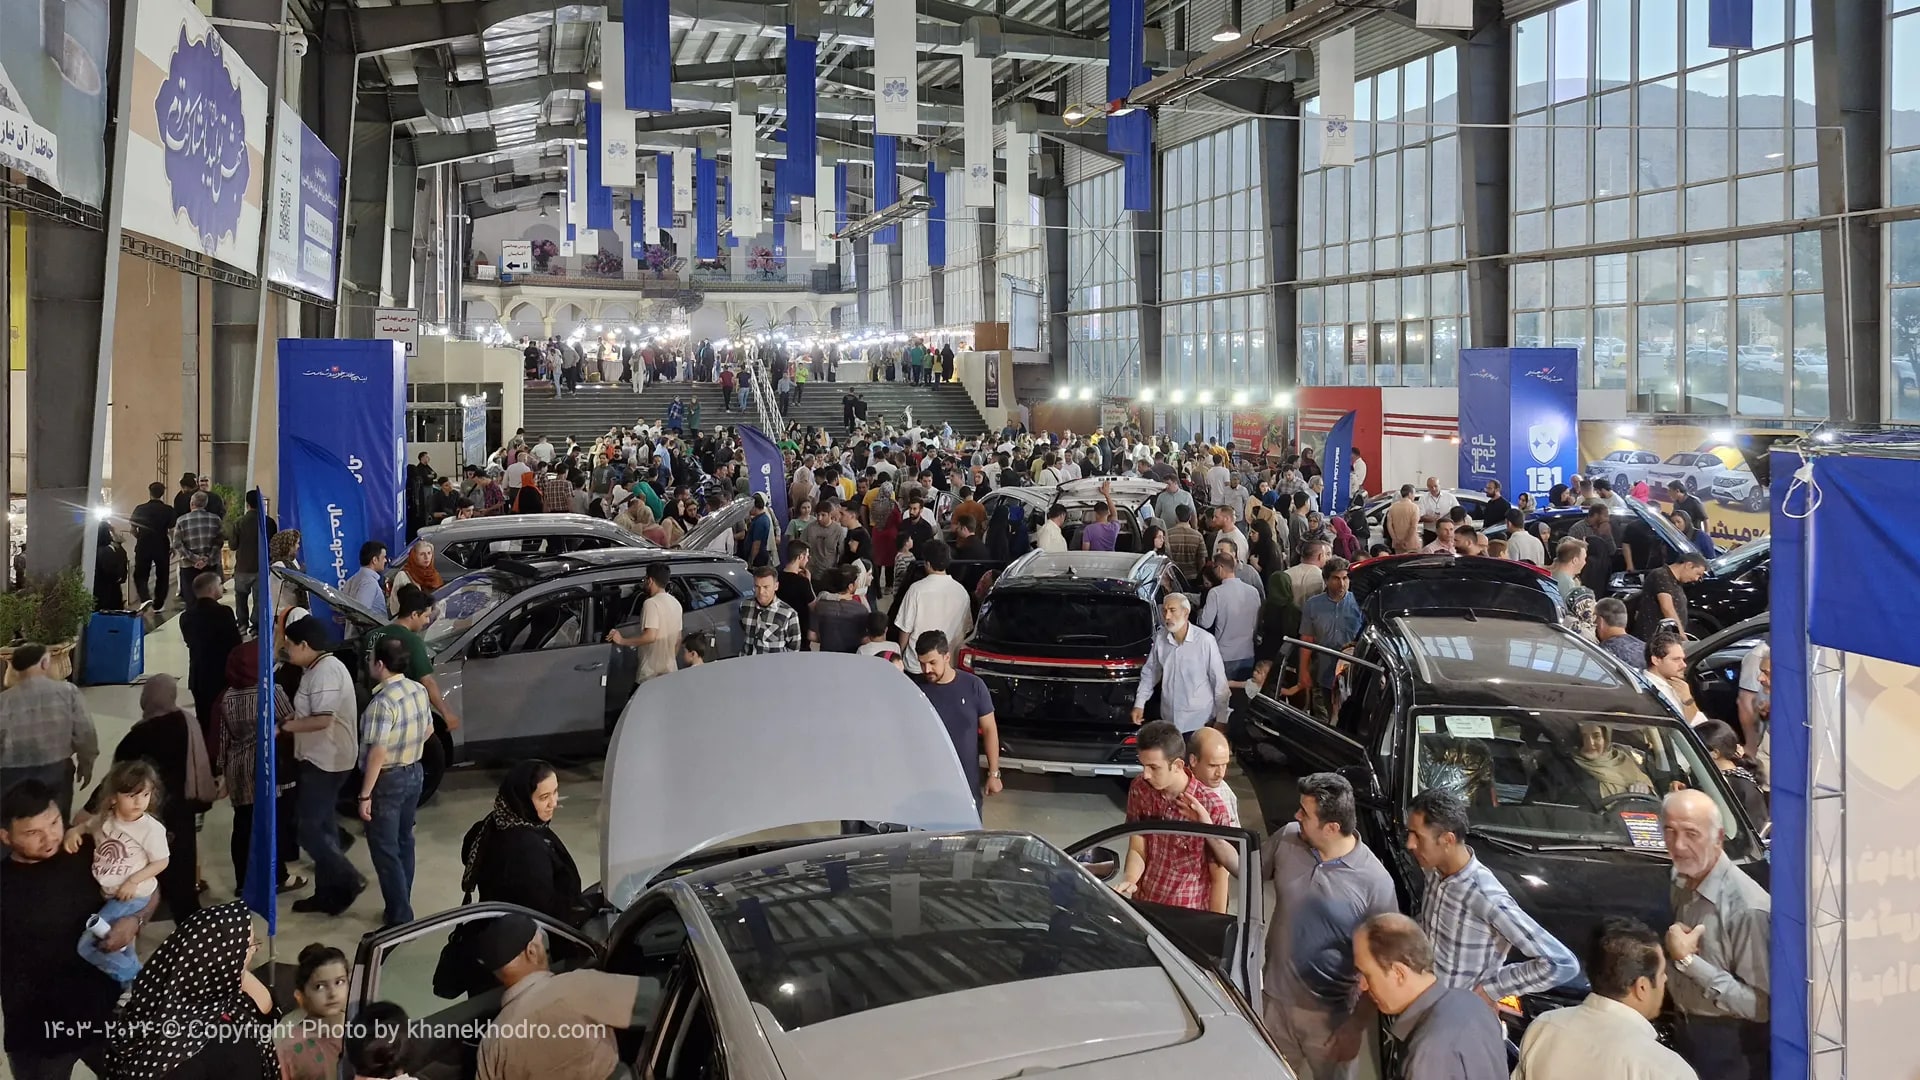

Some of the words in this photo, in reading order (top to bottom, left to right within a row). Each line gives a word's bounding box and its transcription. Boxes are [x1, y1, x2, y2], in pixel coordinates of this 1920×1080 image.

[1471, 434, 1497, 447] خانه
[1471, 447, 1497, 462] خودرو
[1471, 460, 1497, 474] شمال
[1526, 466, 1562, 492] 131
